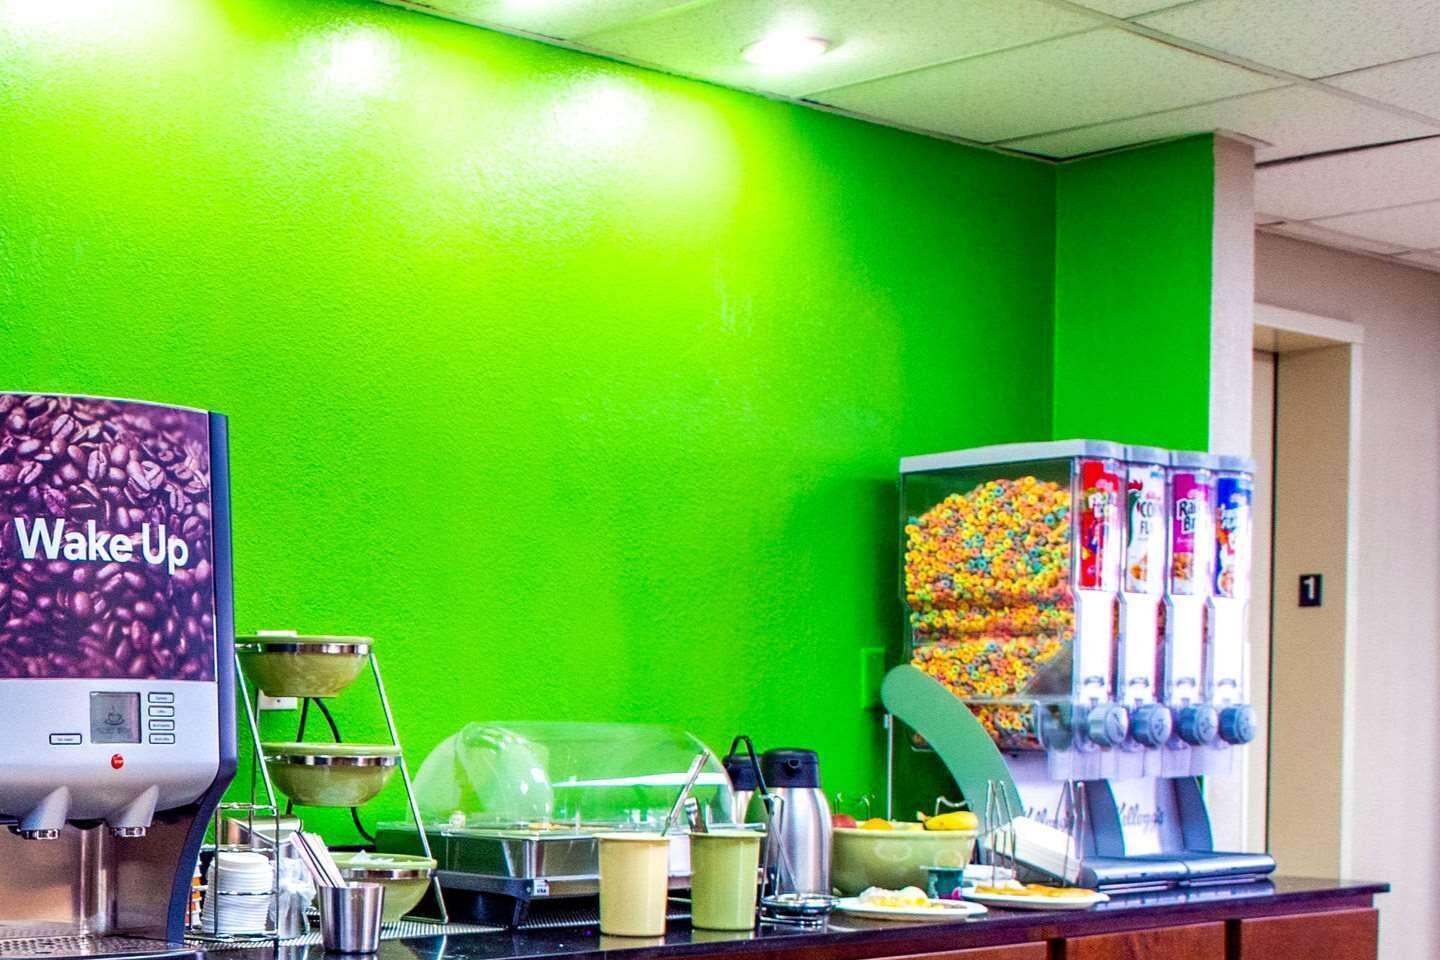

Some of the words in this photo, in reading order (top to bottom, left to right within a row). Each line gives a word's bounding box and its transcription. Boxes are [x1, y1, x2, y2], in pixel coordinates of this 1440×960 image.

[14, 517, 133, 563] Wake
[141, 521, 189, 575] Up
[1303, 576, 1316, 600] 1
